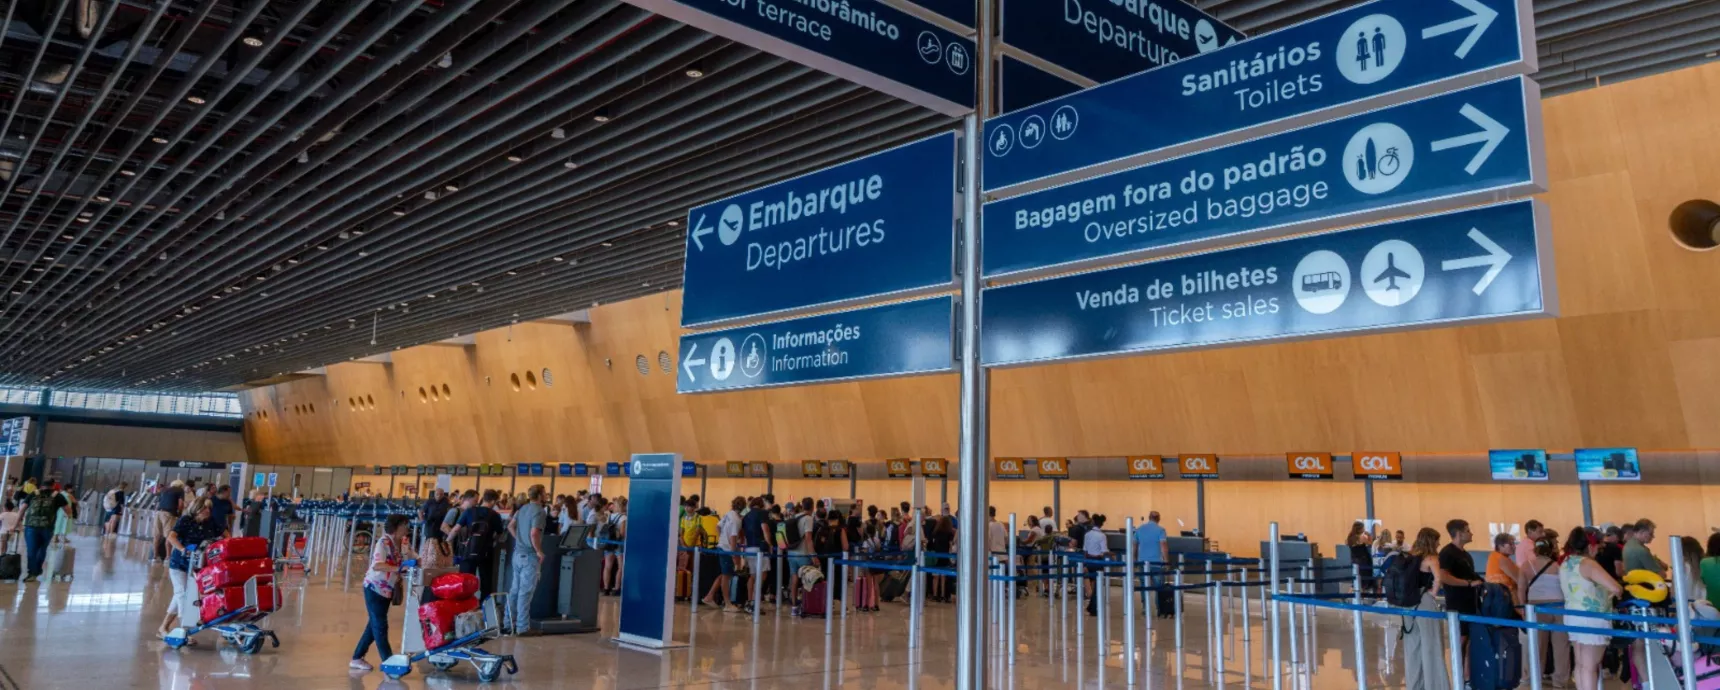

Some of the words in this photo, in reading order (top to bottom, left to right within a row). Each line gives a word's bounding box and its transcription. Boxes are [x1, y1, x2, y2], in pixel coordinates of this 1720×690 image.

[757, 0, 832, 42] terrace
[793, 0, 900, 41] norâmico
[1064, 0, 1181, 66] Departure
[1181, 41, 1321, 96] Sanitários
[1235, 73, 1324, 111] Toilets
[748, 174, 883, 231] Embarque
[1014, 193, 1117, 230] Bagagem
[1124, 183, 1172, 208] fora
[1180, 169, 1215, 195] do
[1223, 144, 1327, 189] padrão
[1084, 200, 1198, 243] Oversized
[1207, 180, 1329, 220] baggage
[746, 218, 886, 271] Departures
[1076, 284, 1139, 310] Venda
[1146, 279, 1174, 300] de
[1182, 265, 1278, 297] bilhetes
[1149, 300, 1214, 328] Ticket
[1222, 295, 1280, 321] sales
[773, 324, 861, 350] Informações
[772, 348, 849, 372] Information
[891, 462, 907, 472] GOL
[926, 461, 942, 472] GOL
[1000, 460, 1019, 472] GOL
[1042, 460, 1062, 472] GOL
[1134, 459, 1158, 471] GOL
[1185, 457, 1211, 470] GOL
[1294, 456, 1325, 470] GOL
[1360, 456, 1393, 470] GOL
